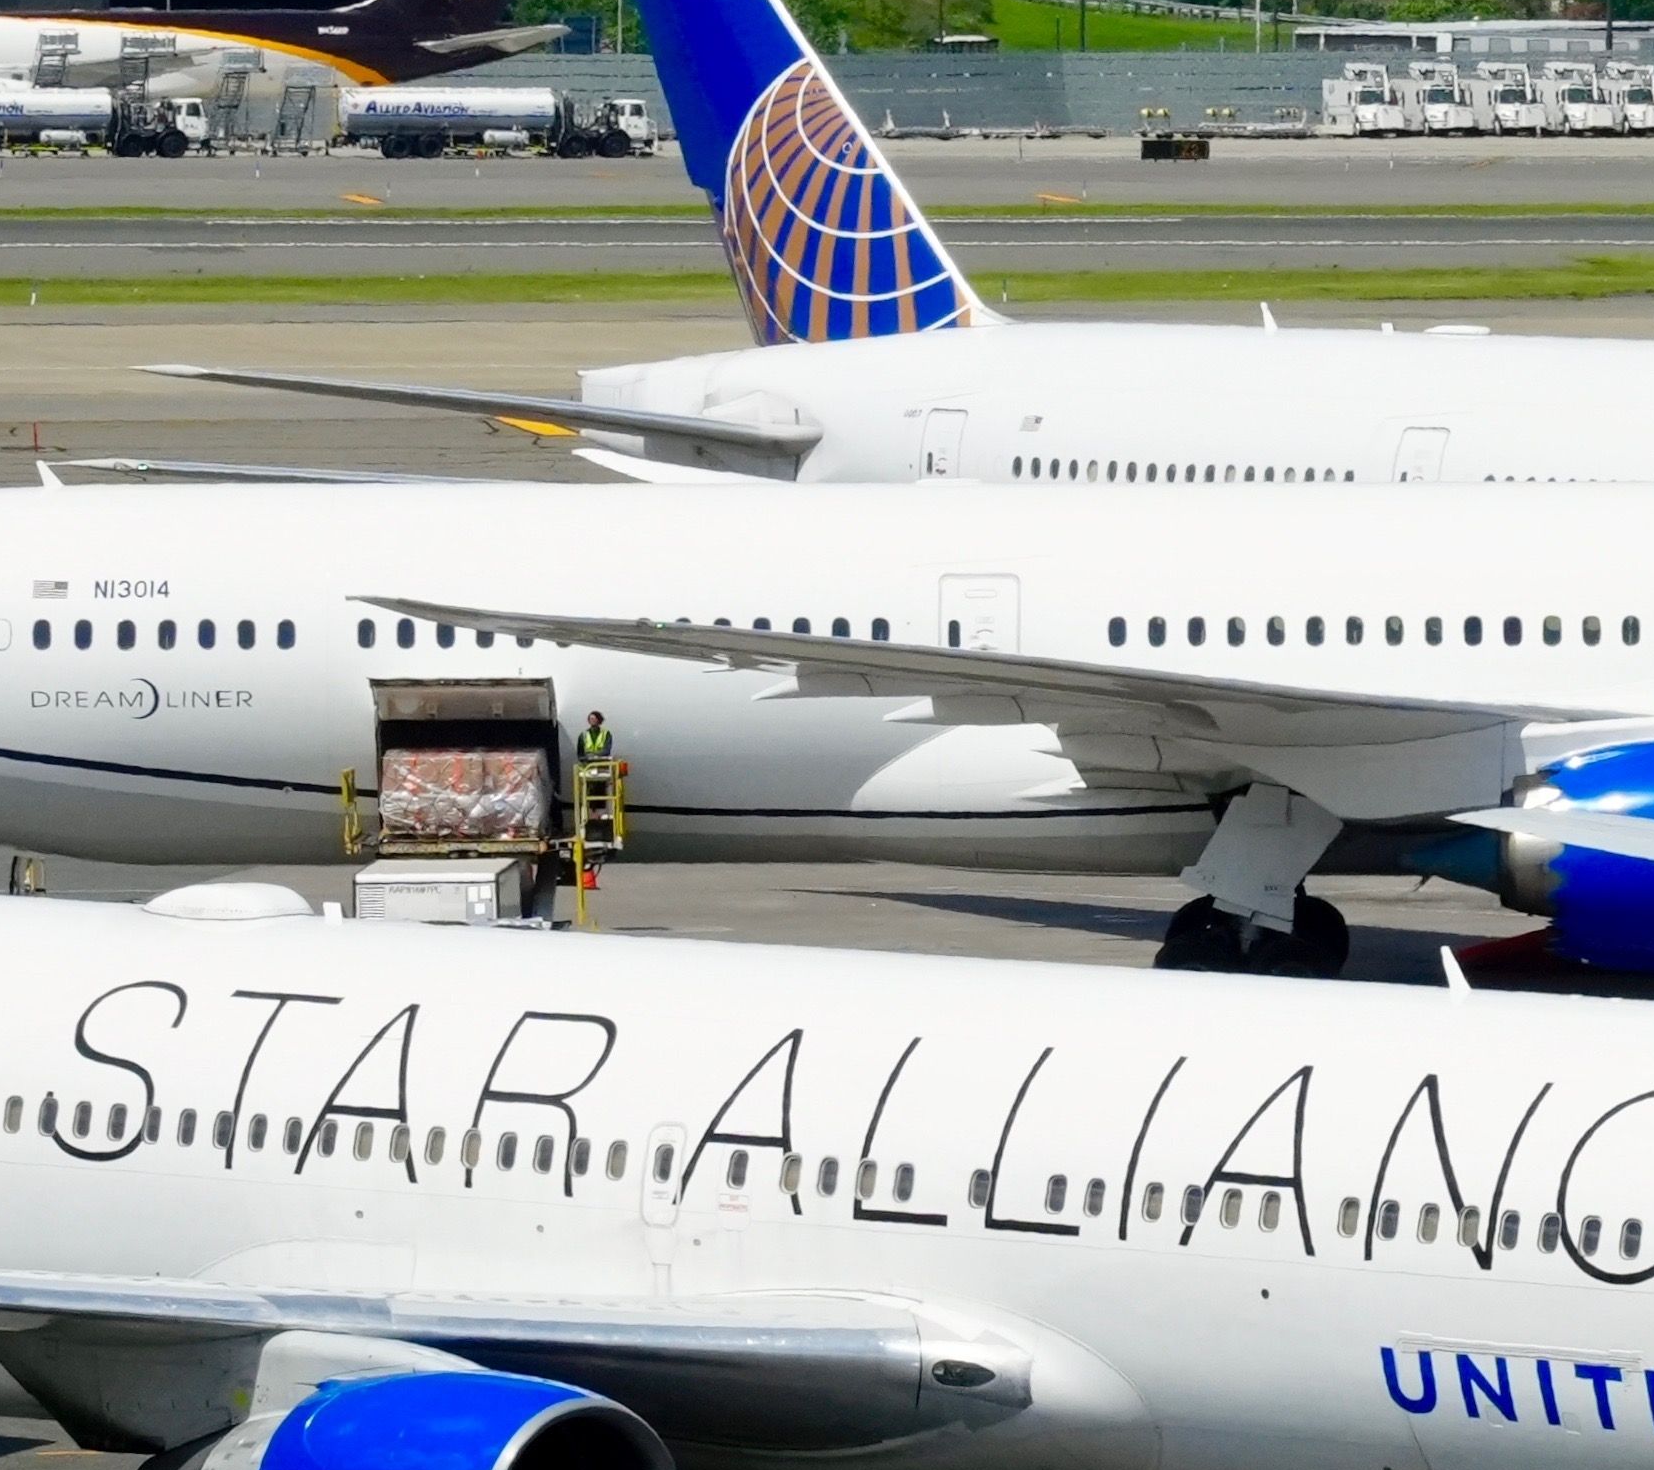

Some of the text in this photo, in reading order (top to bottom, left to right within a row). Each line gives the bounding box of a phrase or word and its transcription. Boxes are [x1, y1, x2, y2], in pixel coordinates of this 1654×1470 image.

[365, 99, 470, 114] ALLIED AVIATION
[94, 580, 169, 598] N13014
[167, 690, 253, 708] LINER
[41, 980, 619, 1198] STAR
